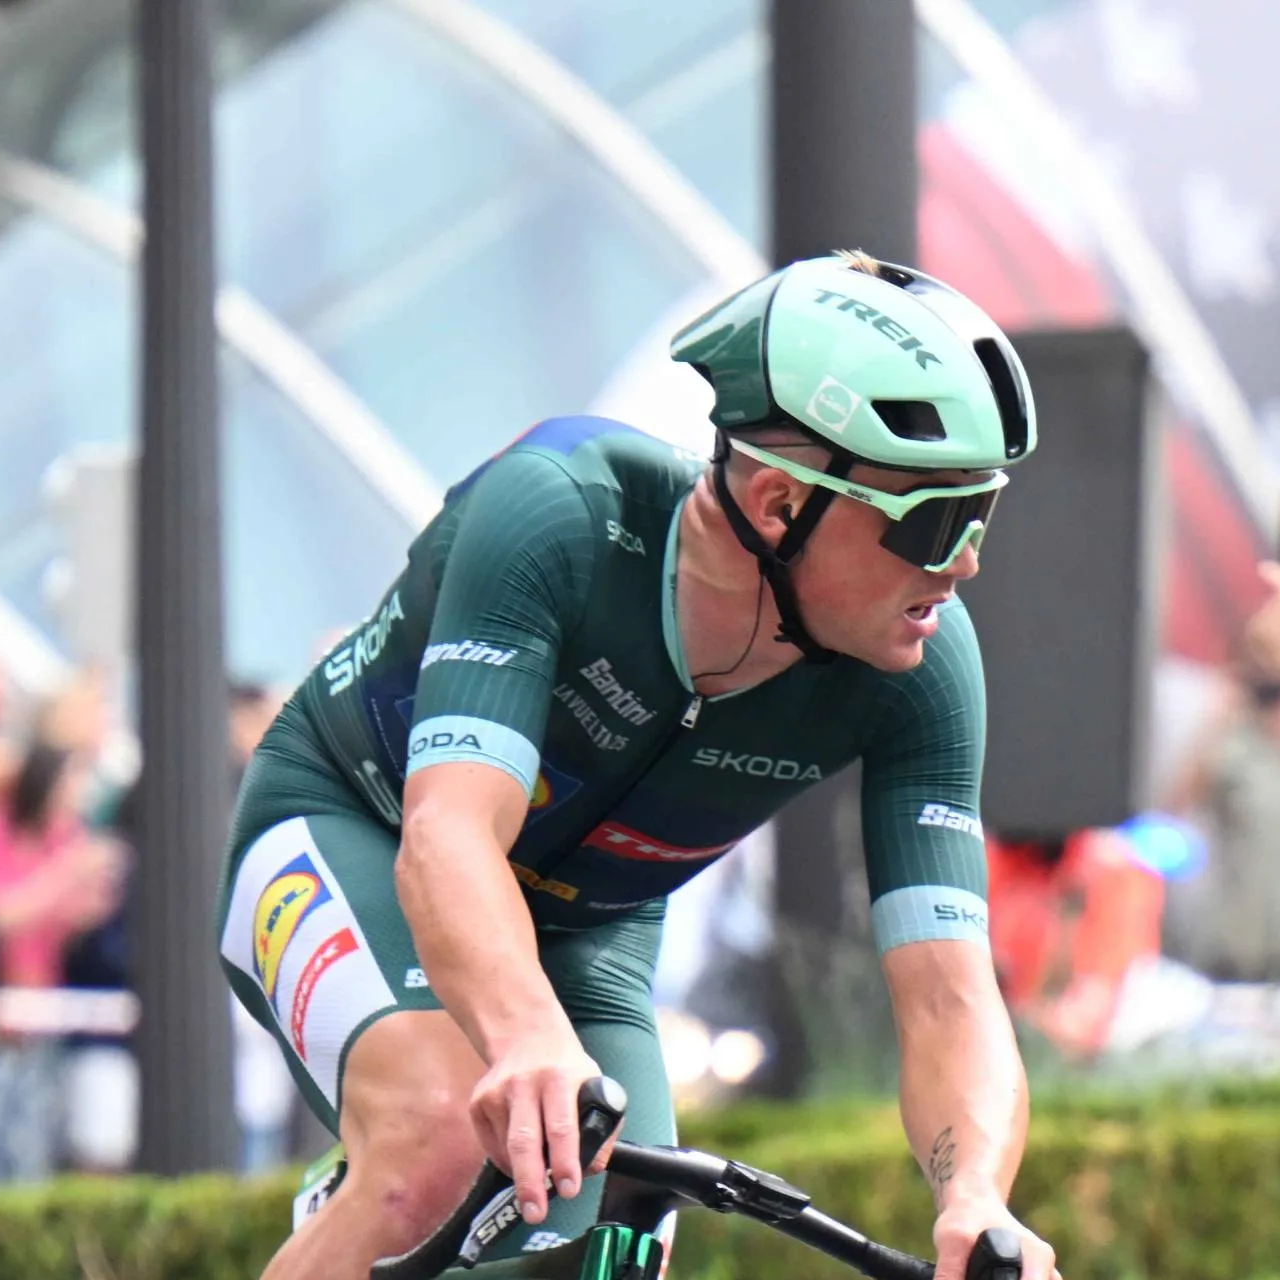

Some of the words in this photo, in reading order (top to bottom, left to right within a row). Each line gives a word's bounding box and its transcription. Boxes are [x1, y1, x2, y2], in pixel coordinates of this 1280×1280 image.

[813, 287, 944, 372] TREK
[579, 656, 659, 727] Santini
[407, 732, 483, 760] ODA
[692, 747, 825, 782] SKODA
[917, 803, 985, 843] San
